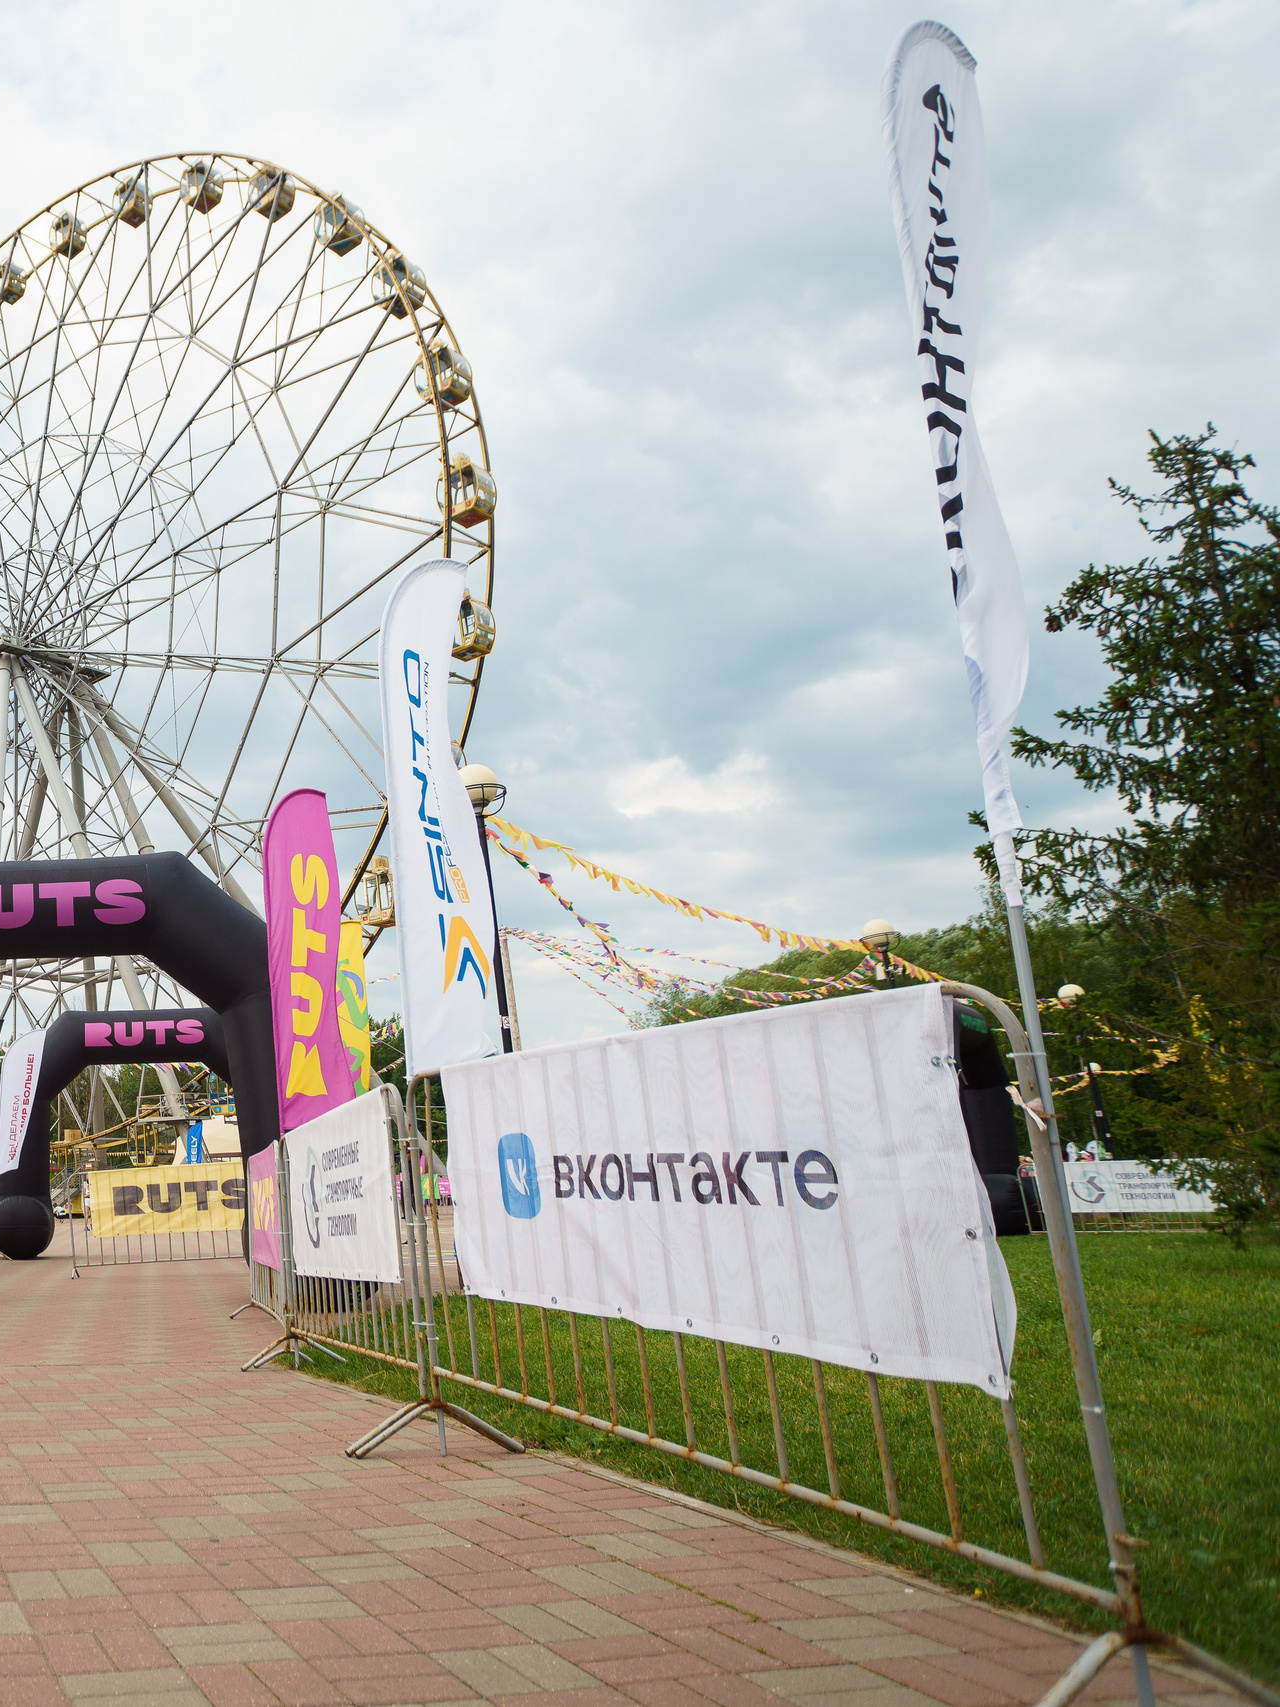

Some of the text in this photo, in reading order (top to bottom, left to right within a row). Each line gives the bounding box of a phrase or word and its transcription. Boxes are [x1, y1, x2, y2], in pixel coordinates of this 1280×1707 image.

[403, 649, 454, 903] SINTO
[286, 853, 329, 1098] RUTS
[85, 1019, 205, 1047] RUTS
[23, 1053, 35, 1105] БОЛЬШЕ!
[9, 1096, 20, 1142] ДЕЛАЕМ
